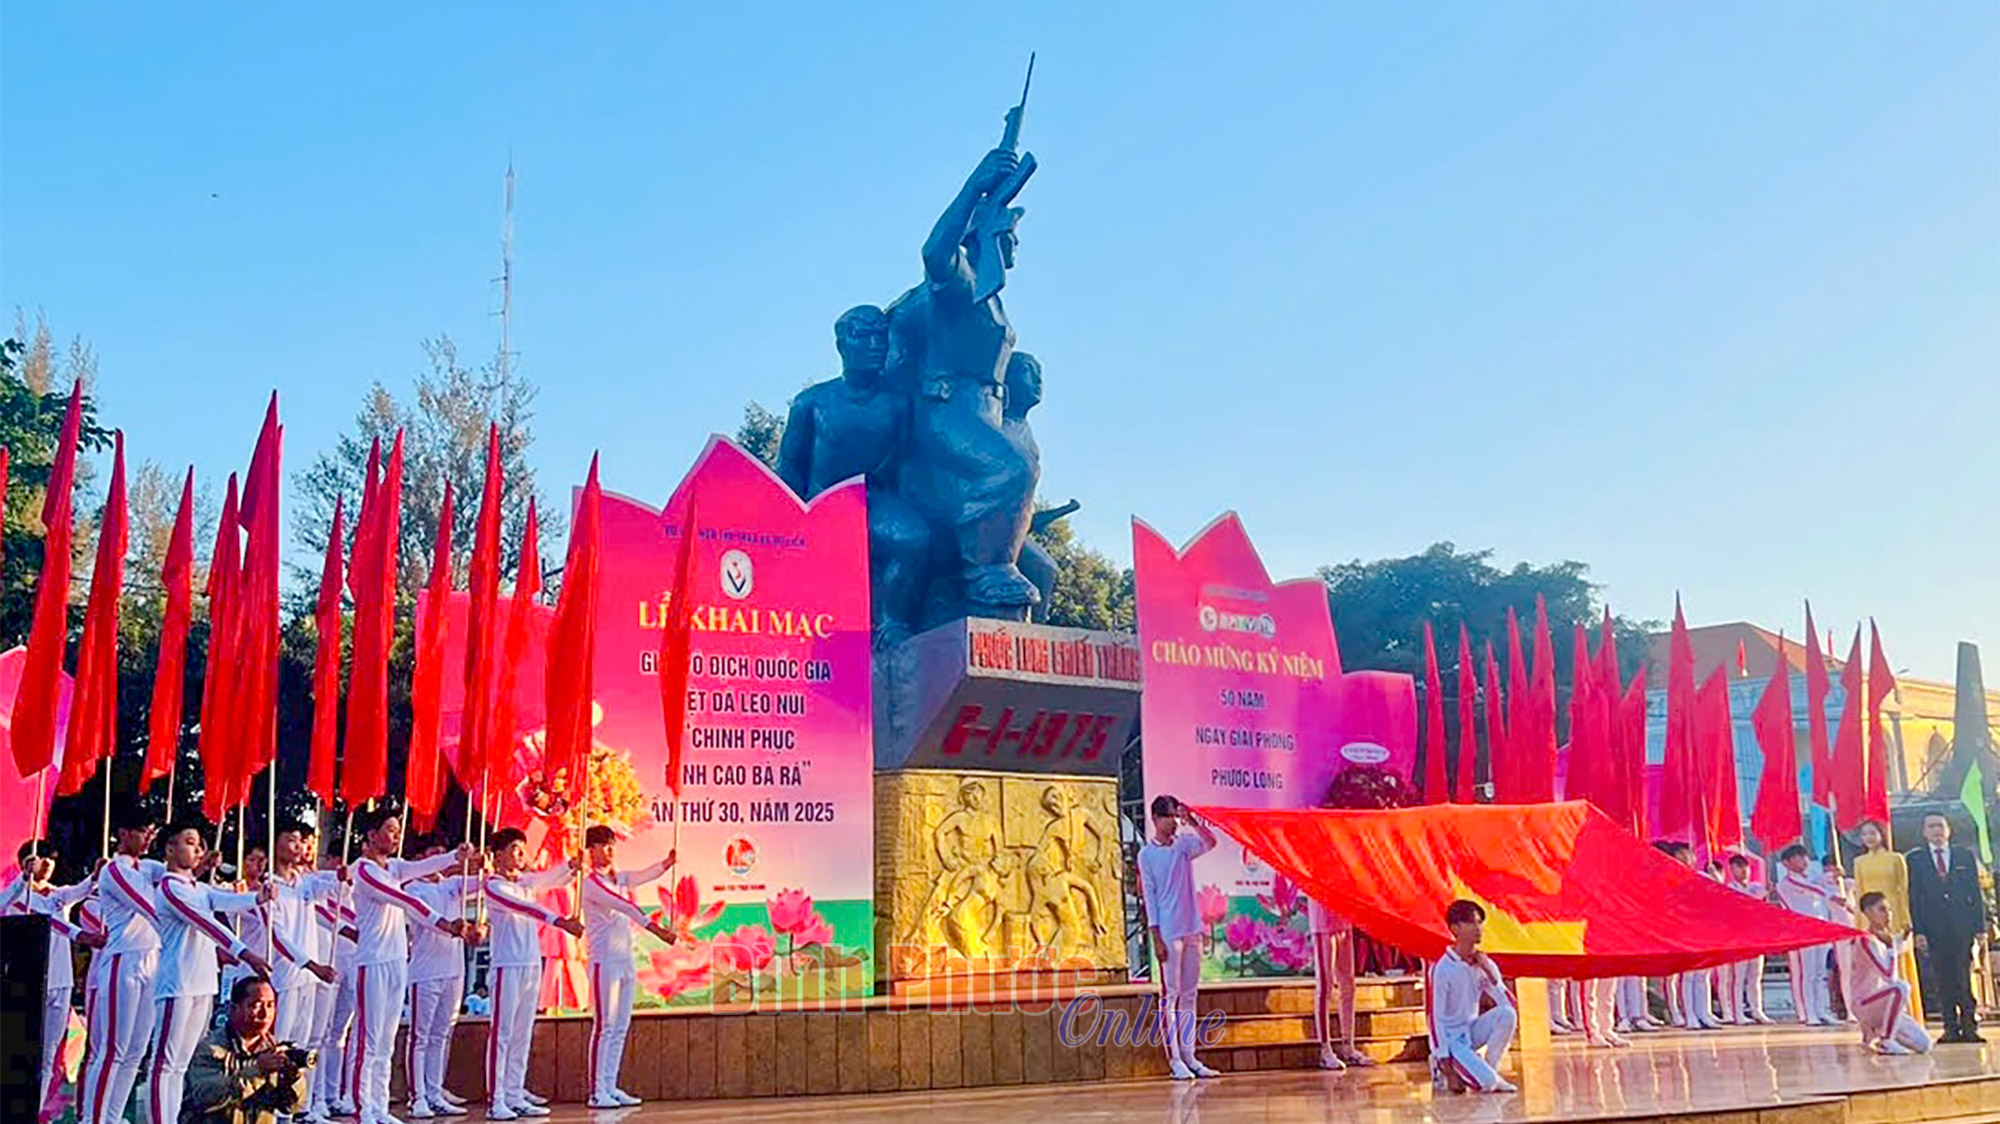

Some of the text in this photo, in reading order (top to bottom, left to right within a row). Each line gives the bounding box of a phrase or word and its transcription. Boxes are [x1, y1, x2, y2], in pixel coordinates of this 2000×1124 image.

[690, 605, 760, 633] KHAI
[768, 609, 834, 643] MẠC
[1152, 637, 1200, 665] CHÀO
[709, 656, 748, 680] ĐỊCH
[805, 661, 831, 682] GIA
[741, 693, 771, 714] LEO
[751, 729, 796, 755] PHỤC
[683, 764, 707, 786] NH
[713, 765, 747, 786] CAO
[651, 793, 674, 822] ẦN
[681, 796, 715, 822] THỨ
[794, 802, 835, 823] 2025
